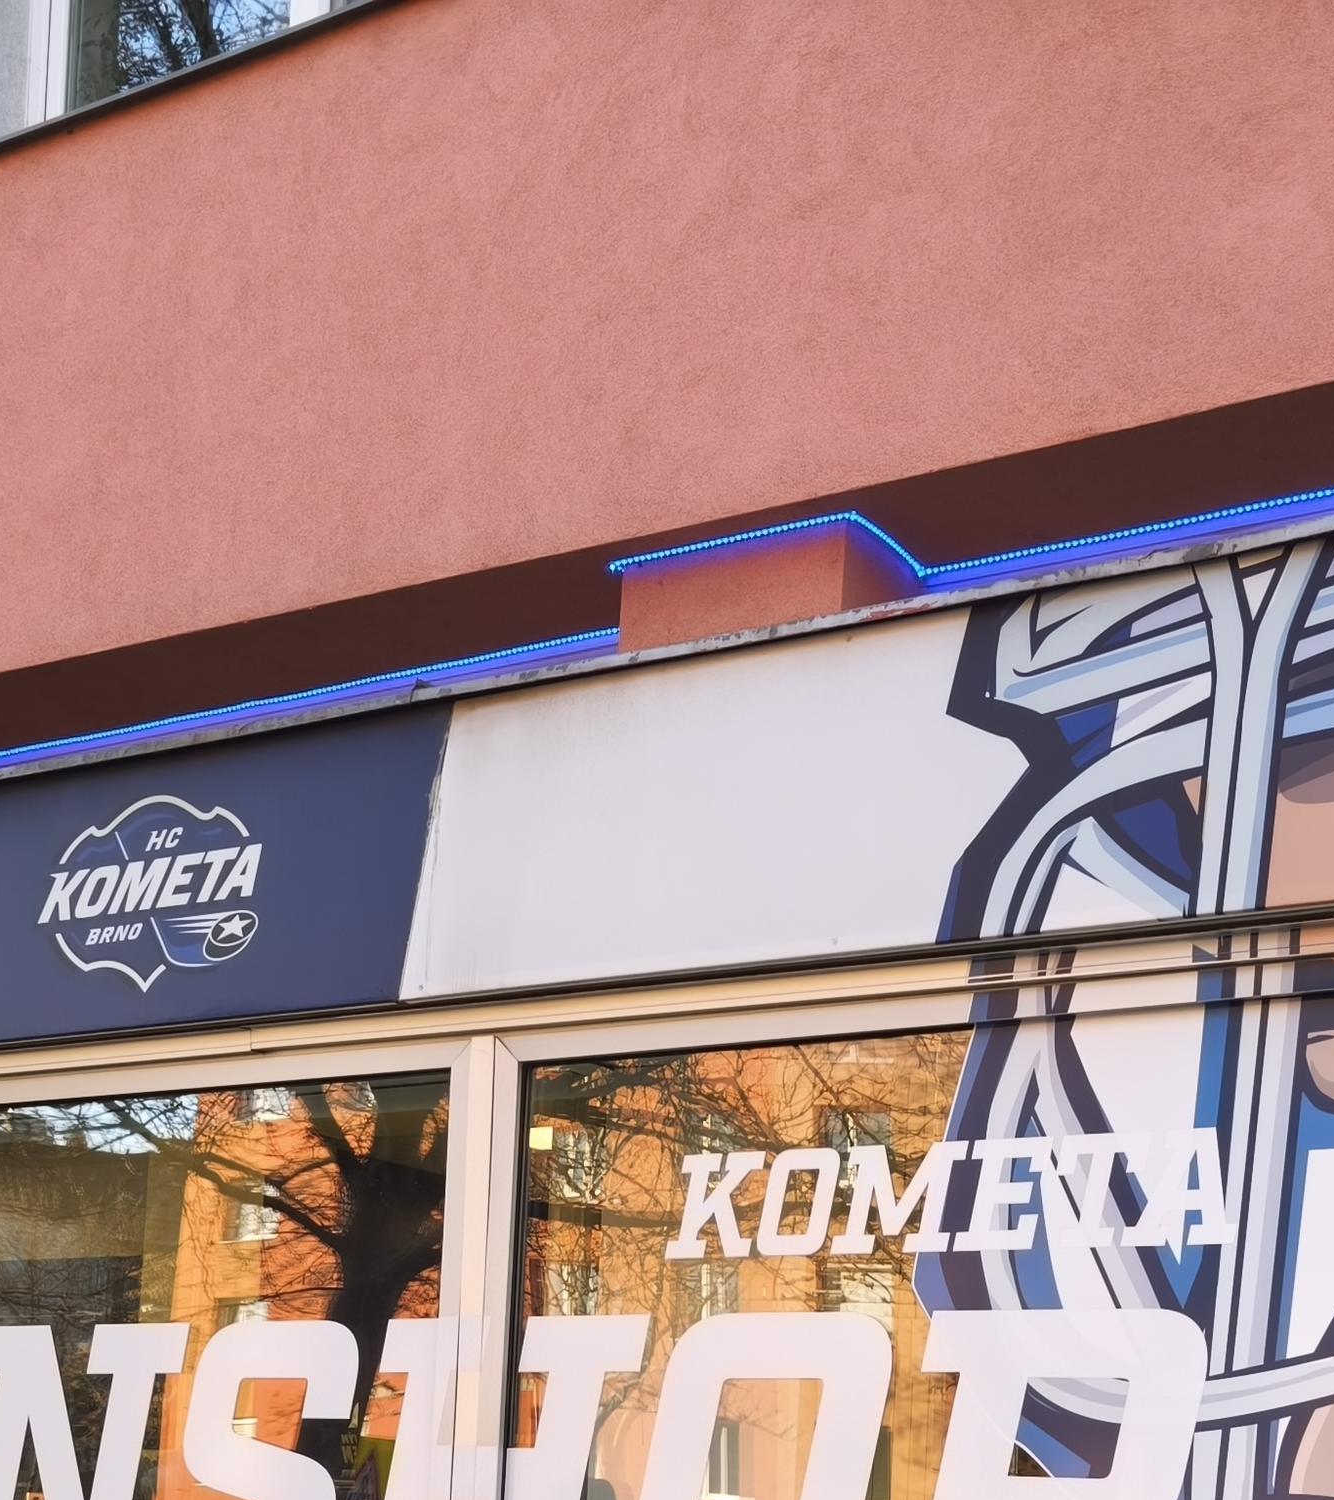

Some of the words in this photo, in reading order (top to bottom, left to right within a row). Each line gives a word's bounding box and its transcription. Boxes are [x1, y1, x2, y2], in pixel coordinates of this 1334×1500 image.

[145, 826, 184, 852] HC
[37, 843, 263, 924] KOMETA
[85, 922, 144, 946] BRNO
[665, 1126, 1235, 1260] KOMETA
